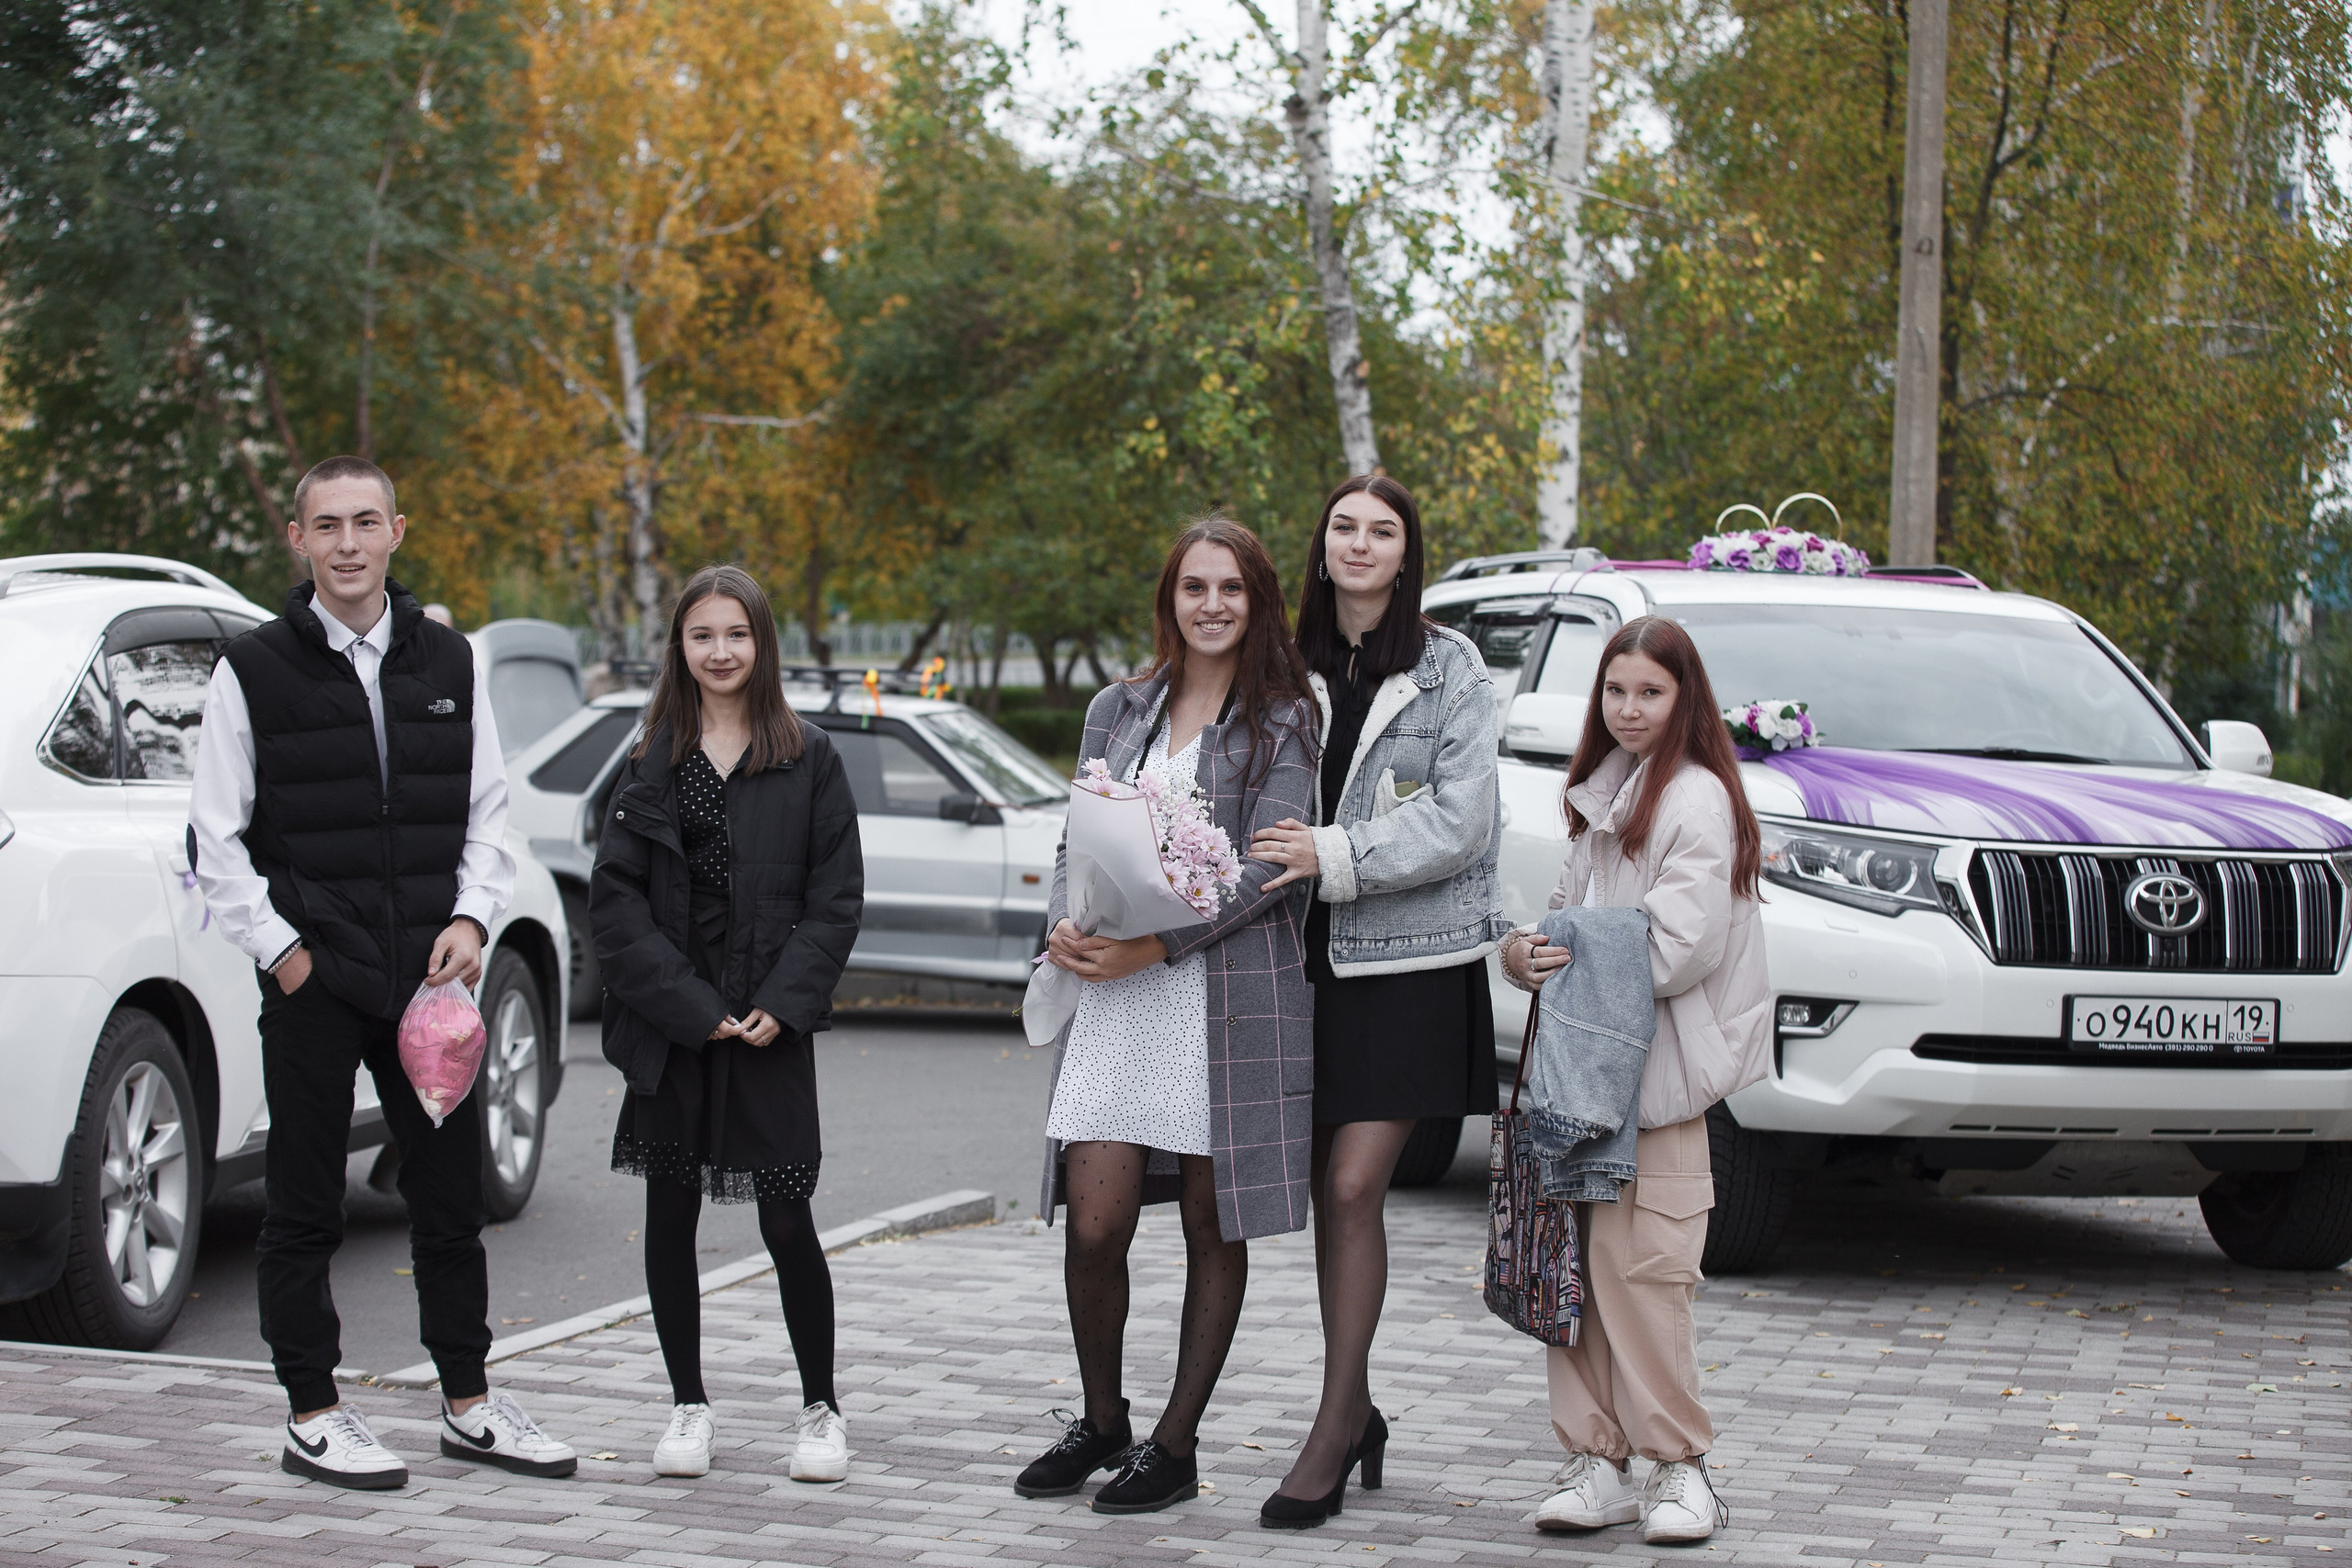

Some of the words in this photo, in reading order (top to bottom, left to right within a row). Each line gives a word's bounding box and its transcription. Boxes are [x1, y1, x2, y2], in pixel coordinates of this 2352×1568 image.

[2233, 1005, 2263, 1031] 19
[2228, 1032, 2252, 1043] RUS
[2165, 1043, 2182, 1053] (391)
